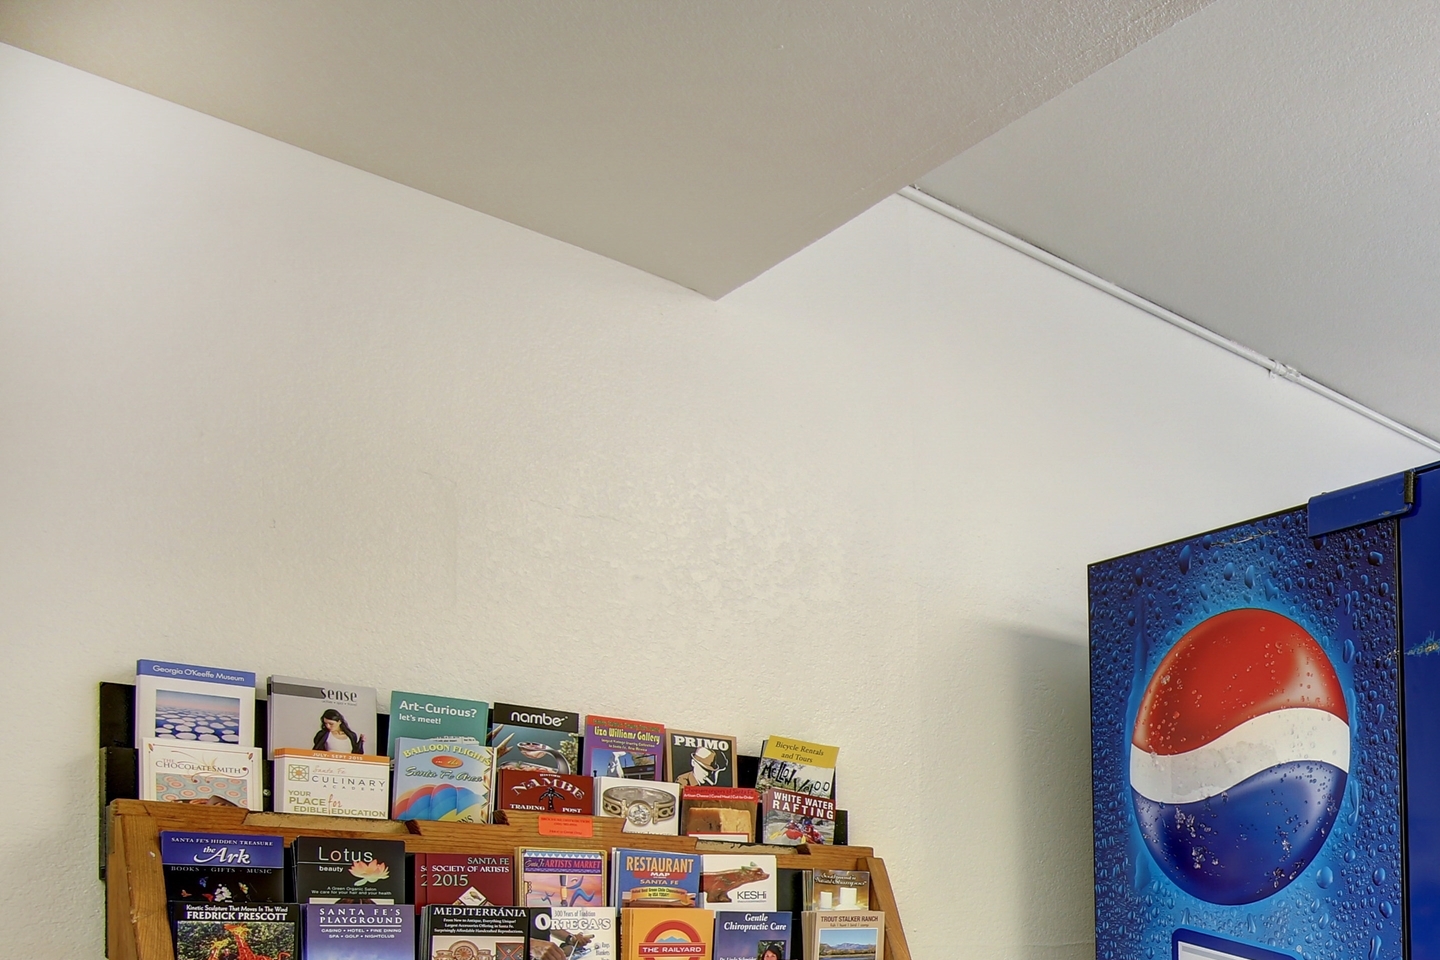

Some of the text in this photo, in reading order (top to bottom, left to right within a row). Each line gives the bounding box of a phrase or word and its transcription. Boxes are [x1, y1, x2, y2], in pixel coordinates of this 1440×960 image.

[152, 665, 245, 682] Georgia O'Keeffe Museum
[321, 688, 358, 702] sense
[400, 700, 477, 718] Art-Curious?
[594, 726, 661, 744] Liza Williams Gallery
[673, 735, 729, 751] PRIMO
[775, 741, 798, 751] Bicycle
[800, 745, 824, 756] Rentals
[402, 744, 492, 766] BALLOON FLIGHTS
[311, 775, 385, 788] CULINARY
[288, 797, 326, 807] PLACE
[774, 791, 834, 810] WHITE WATER
[294, 806, 385, 817] EDIBLE EDUCATION
[772, 802, 834, 820] RAFTING
[318, 846, 373, 862] Lotus
[467, 857, 494, 865] SANTA
[545, 859, 600, 869] ARTISTS MARKET
[626, 855, 694, 873] RESTAURANT
[319, 865, 344, 873] beauty
[432, 865, 509, 873] SOCIETY OF ARTISTS
[432, 874, 468, 887] 2015
[187, 912, 288, 921] FREDRICK PRESCOTT
[374, 908, 401, 916] FE'S
[744, 913, 768, 922] Gentle
[320, 916, 402, 924] PLAYGROUND
[535, 913, 611, 930] ORTEGA'S
[723, 921, 787, 932] Chiropractic Care
[662, 946, 702, 954] RAILYARD
